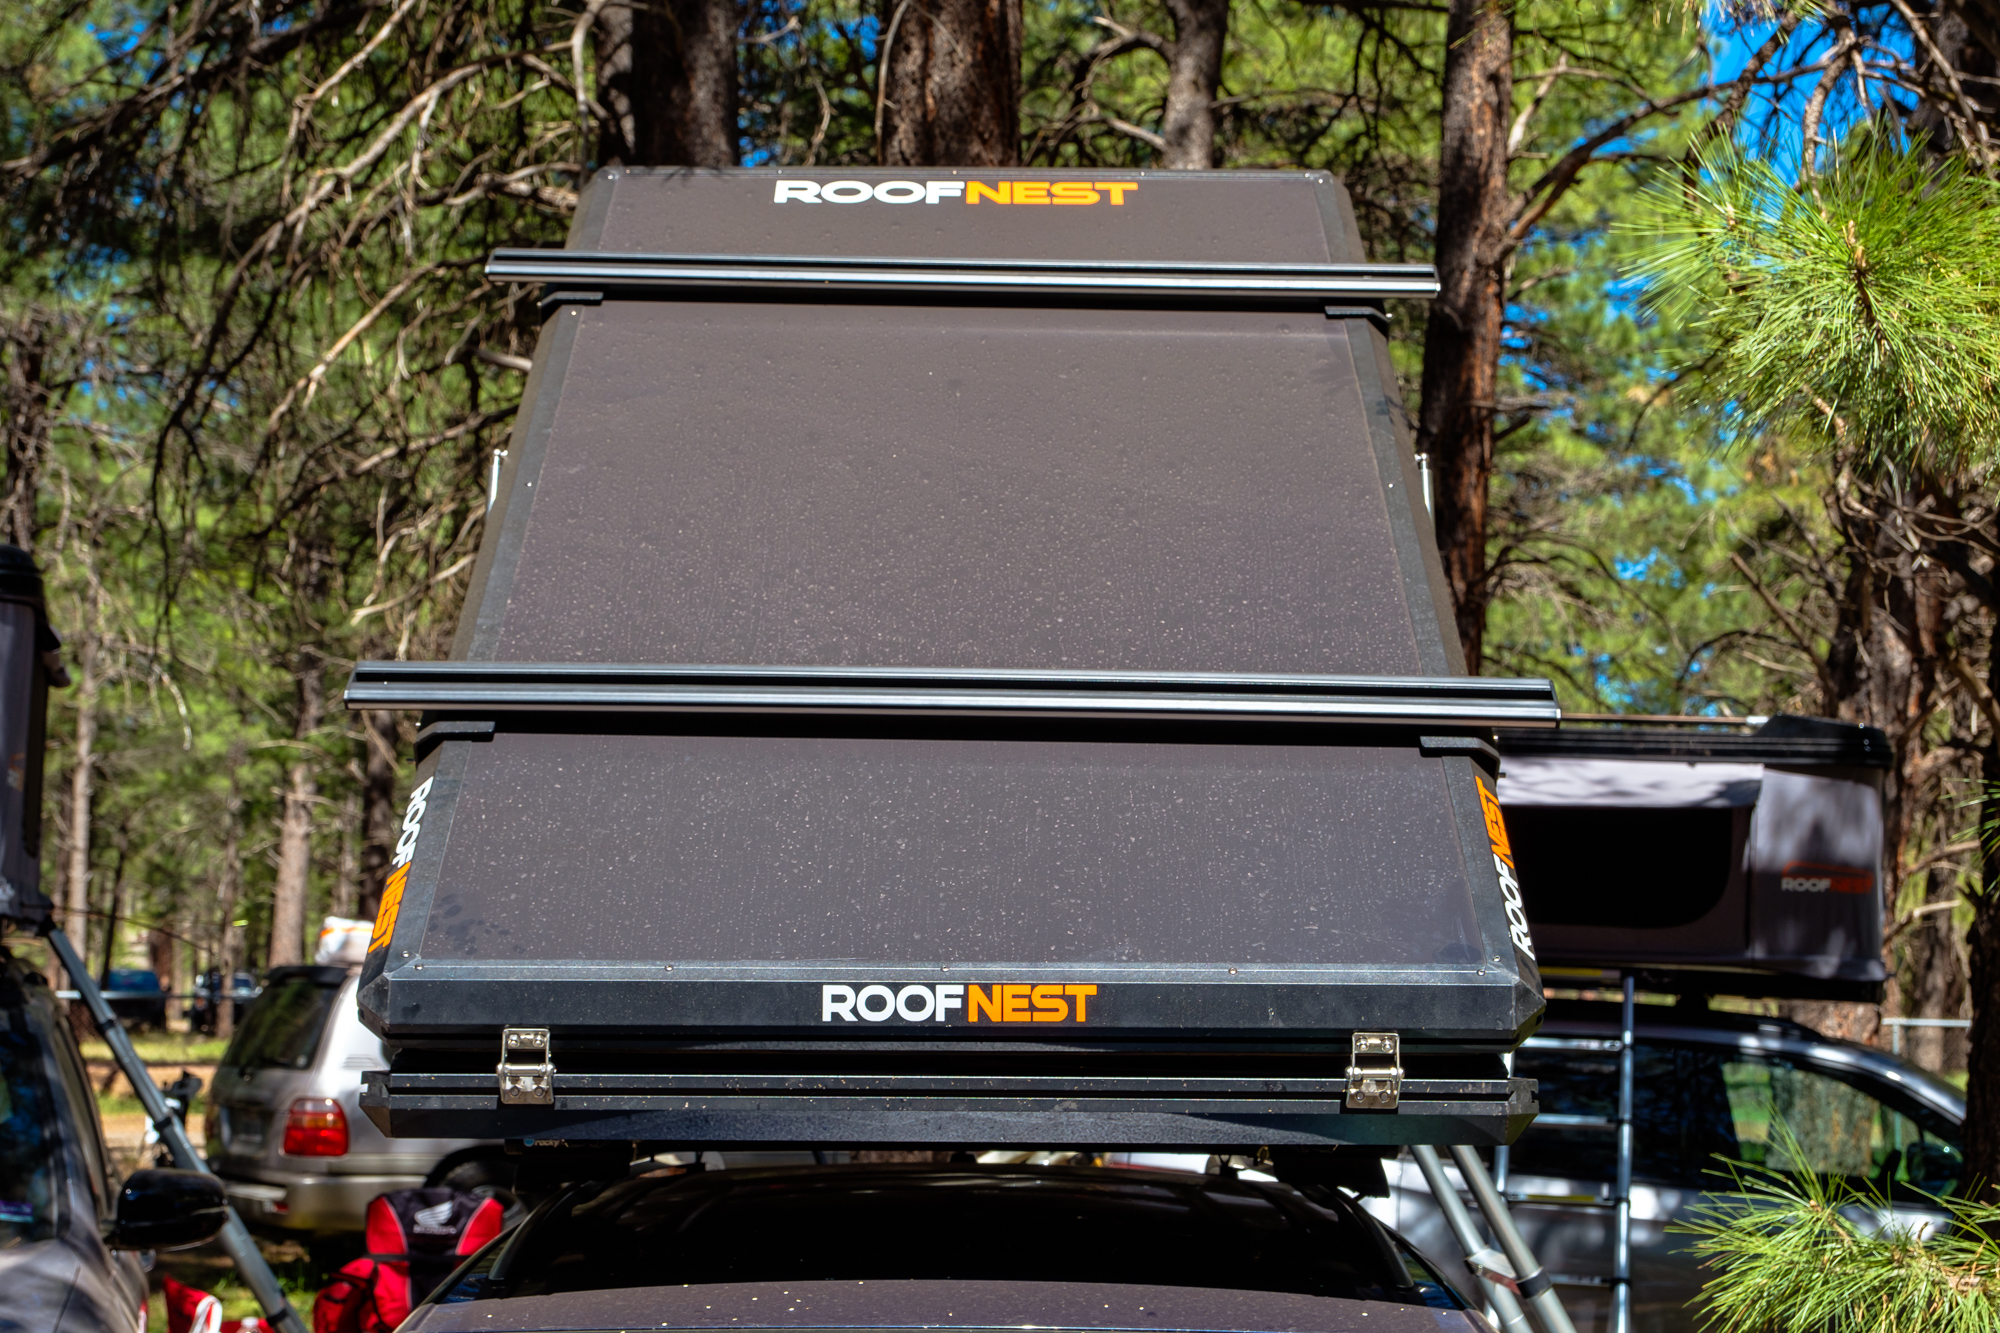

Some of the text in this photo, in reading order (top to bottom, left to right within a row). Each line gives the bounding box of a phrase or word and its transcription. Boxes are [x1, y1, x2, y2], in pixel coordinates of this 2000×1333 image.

[774, 180, 1138, 205] ROOFNEST
[368, 776, 434, 953] ROOFNEST
[1475, 776, 1535, 961] ROOFNEST
[822, 984, 1098, 1022] ROOFNEST
